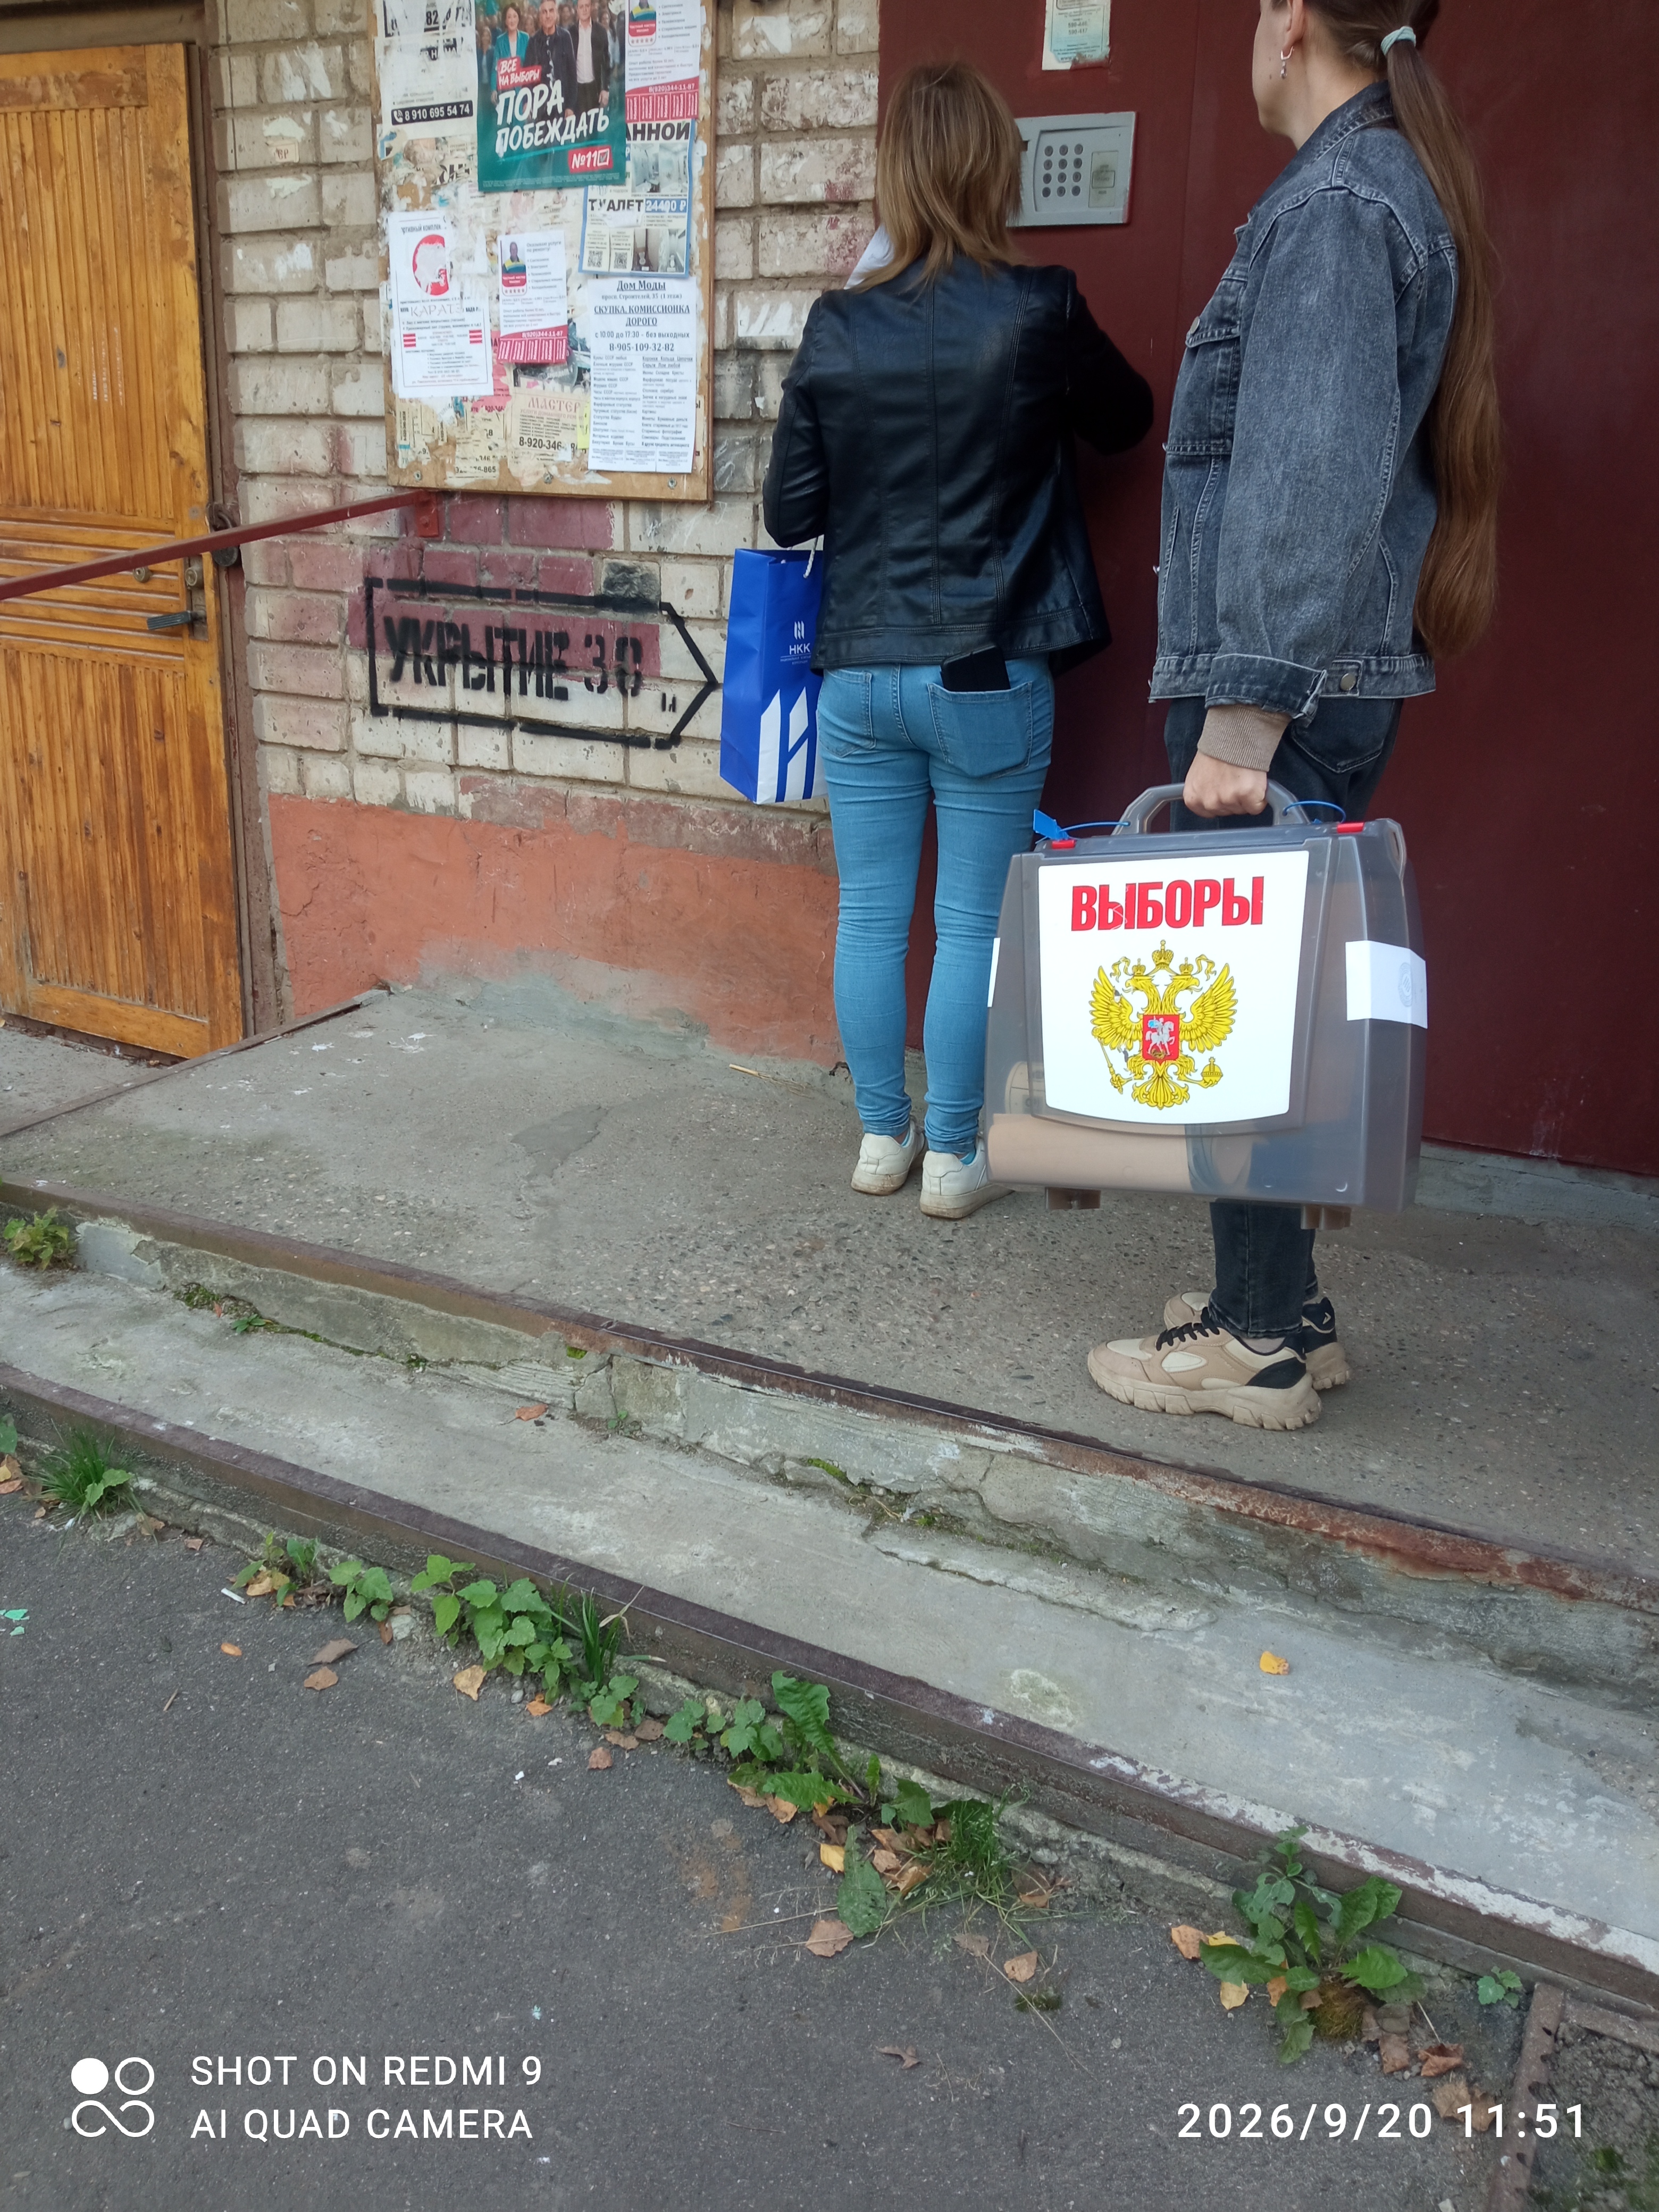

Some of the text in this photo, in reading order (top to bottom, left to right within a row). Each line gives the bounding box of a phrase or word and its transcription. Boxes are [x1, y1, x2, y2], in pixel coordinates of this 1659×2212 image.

[500, 58, 517, 74] ВСЕ
[499, 70, 540, 87] НА ВЫБОРЫ
[649, 83, 695, 93] 8(920)344-11-87
[496, 79, 564, 125] ПОРА
[405, 103, 470, 121] 8 910 695 54 74
[496, 107, 609, 152] ПОБЕЖДАТЬ
[572, 150, 598, 169] №11
[589, 198, 643, 212] ТУАЛЕТ
[617, 280, 666, 291] Дом Моды
[629, 305, 690, 314] КОМИССИОНКА
[626, 317, 657, 326] ДОРОГО
[609, 343, 674, 351] 8-905-109-32-82
[528, 397, 581, 413] МАСТЕР
[789, 643, 810, 655] НКК
[384, 616, 569, 701] УКРЫТИЕ
[584, 634, 642, 697] 30
[1071, 876, 1264, 931] ВЫБОРЫ
